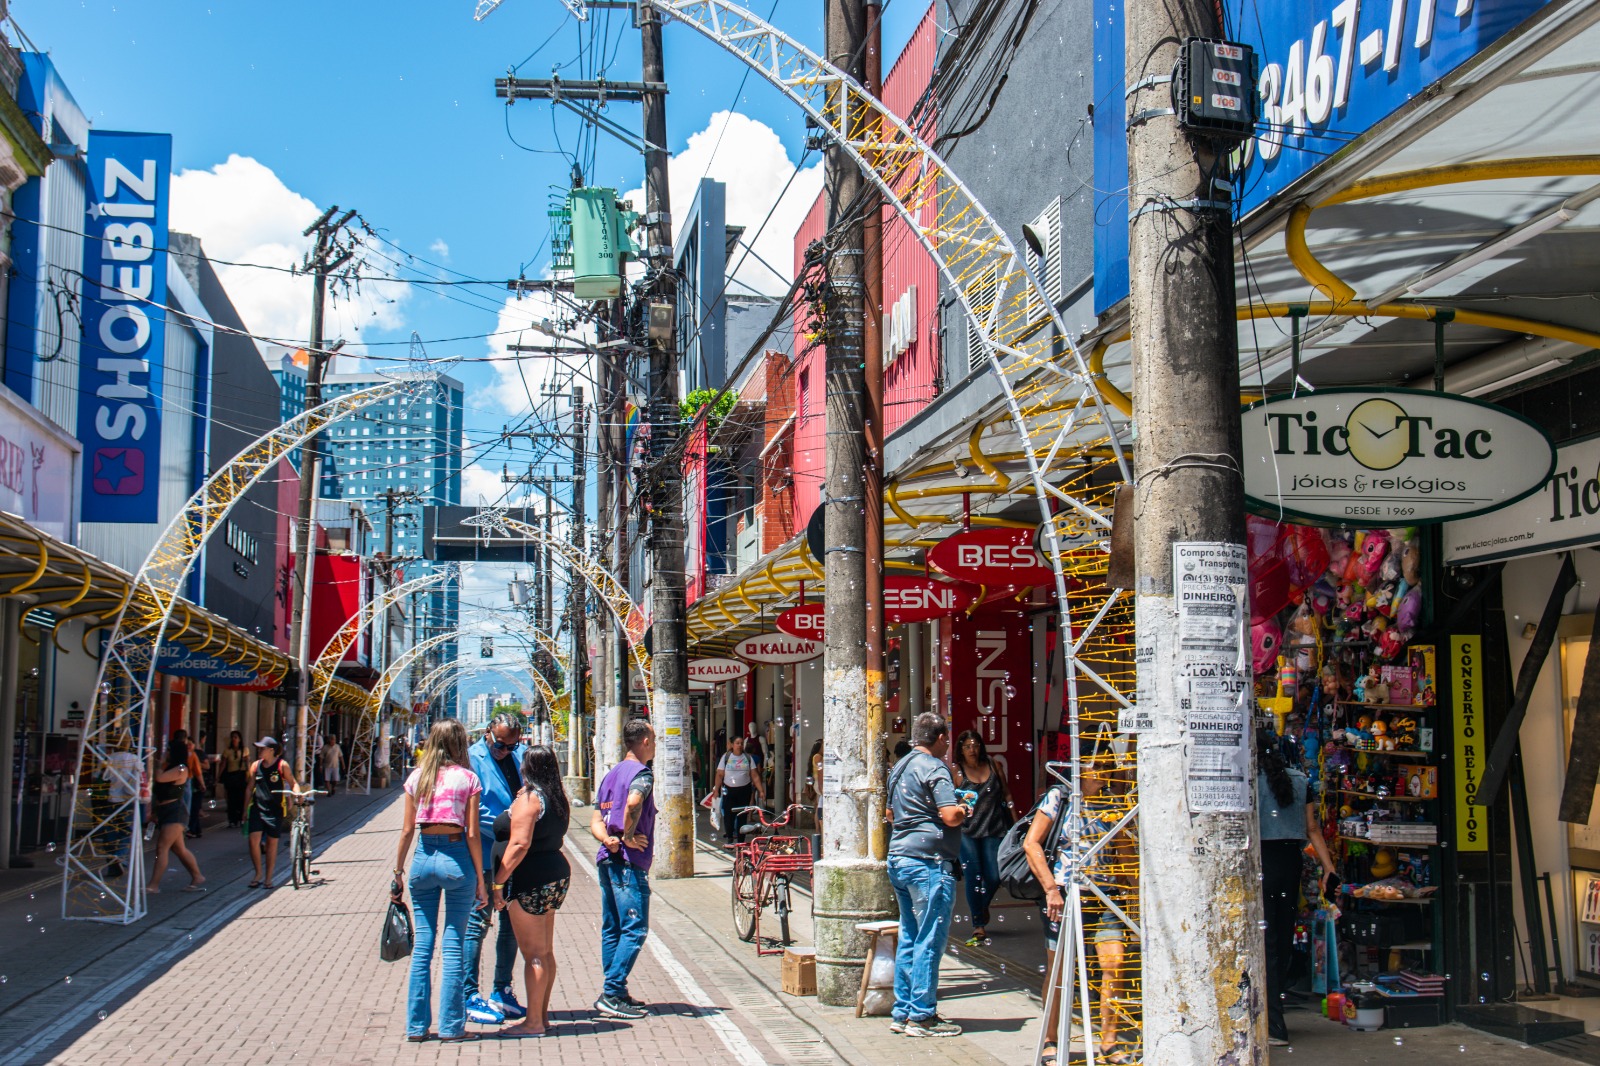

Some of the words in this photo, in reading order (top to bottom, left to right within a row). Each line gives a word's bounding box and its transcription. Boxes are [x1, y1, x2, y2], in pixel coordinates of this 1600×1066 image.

[1217, 46, 1239, 57] SVE
[1216, 71, 1236, 82] 001
[1264, 410, 1350, 457] Tic
[1395, 415, 1493, 460] Tac
[1291, 473, 1348, 491] jóias
[1353, 474, 1368, 493] &
[1372, 476, 1467, 494] relógios
[1344, 506, 1381, 515] DESDE
[1386, 507, 1416, 516] 1969
[958, 544, 1044, 568] BES
[1180, 548, 1215, 559] Compro
[1199, 558, 1240, 569] Transporte
[1183, 593, 1237, 602] DINHEIRO?
[760, 643, 815, 655] KALLAN
[698, 665, 741, 675] KALLAN
[1460, 643, 1476, 738] CONSERTO
[1190, 713, 1231, 721] PRECISANDO
[1190, 722, 1243, 731] DINHEIRO?
